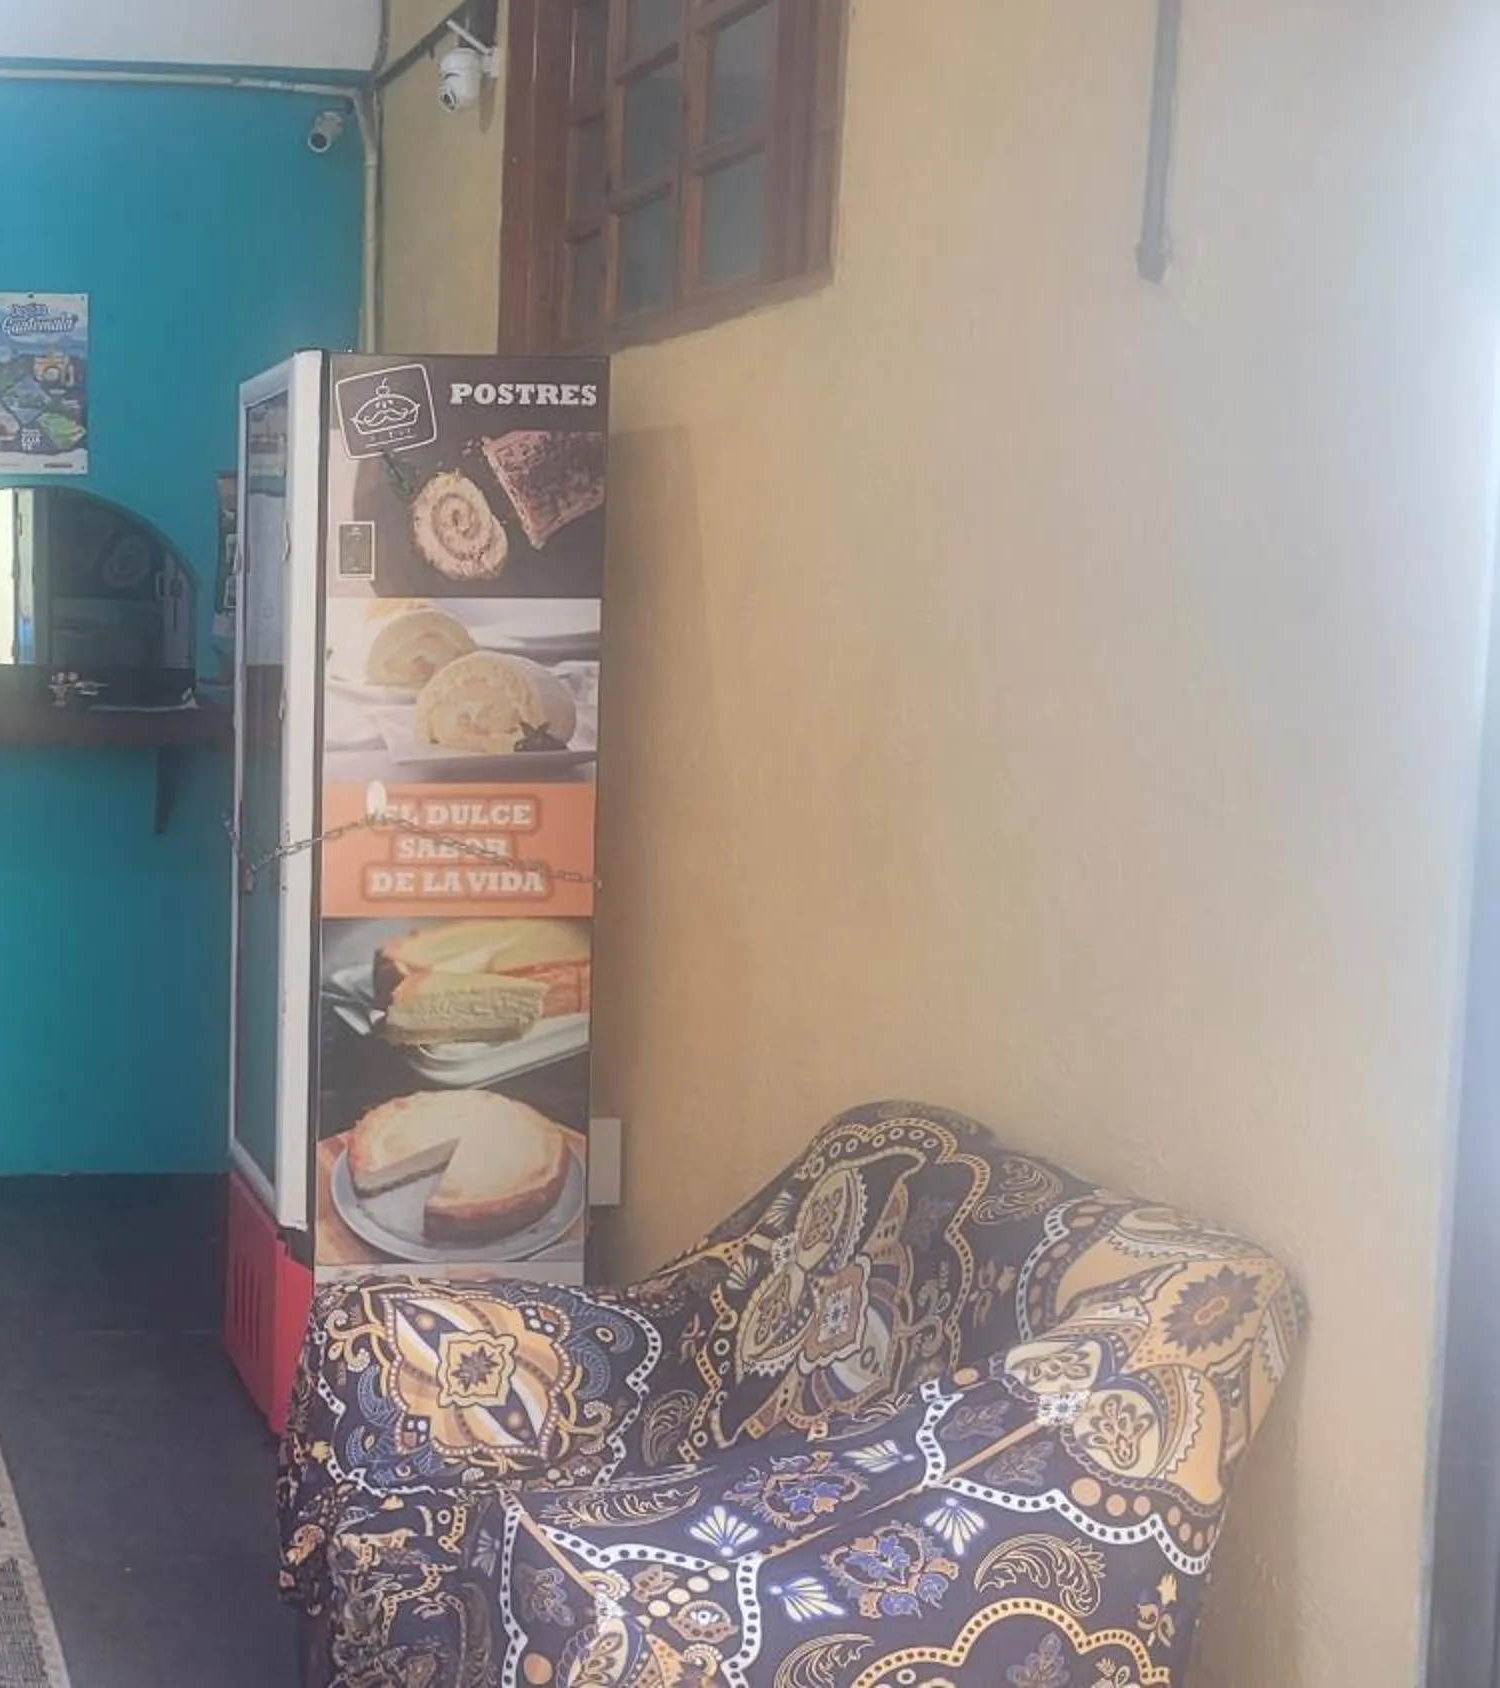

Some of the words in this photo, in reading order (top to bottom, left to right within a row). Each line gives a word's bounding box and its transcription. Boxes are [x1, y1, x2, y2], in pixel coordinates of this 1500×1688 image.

[450, 383, 597, 406] POSTRES
[427, 805, 532, 825] DULCE
[398, 837, 511, 859] SABOR
[370, 872, 414, 893] DE
[423, 872, 462, 893] LA
[466, 871, 544, 892] VIDA
